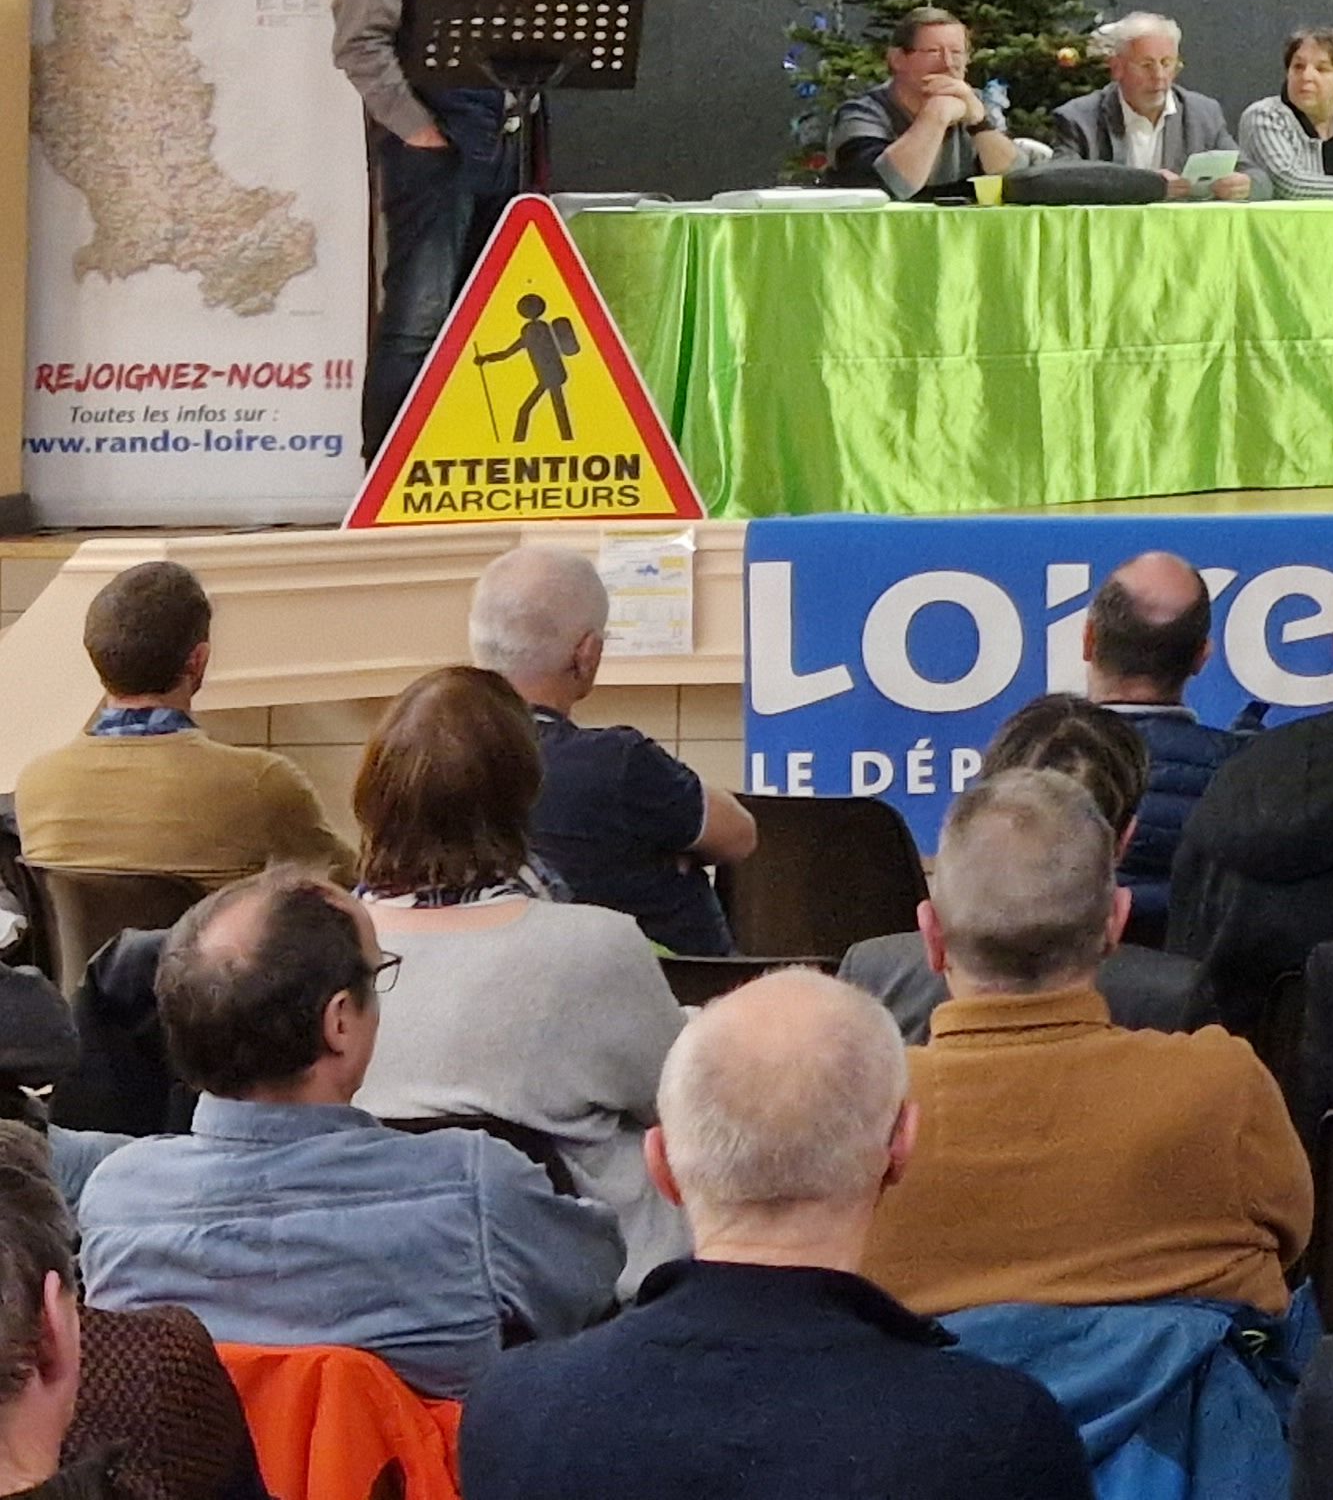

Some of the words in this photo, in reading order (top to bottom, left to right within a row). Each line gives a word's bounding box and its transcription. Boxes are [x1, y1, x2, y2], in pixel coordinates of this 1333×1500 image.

[35, 361, 313, 394] REJOIGNEZ-NOUS
[324, 359, 354, 390] !!!
[70, 406, 135, 424] Toutes
[142, 406, 169, 423] les
[177, 404, 227, 423] infos
[234, 407, 267, 422] sur
[22, 429, 343, 457] ww.rando-loire.org
[404, 454, 641, 488] ATTENTION
[403, 485, 641, 514] MARCHEURS
[752, 752, 814, 796] LE
[852, 738, 982, 796] DÉP
